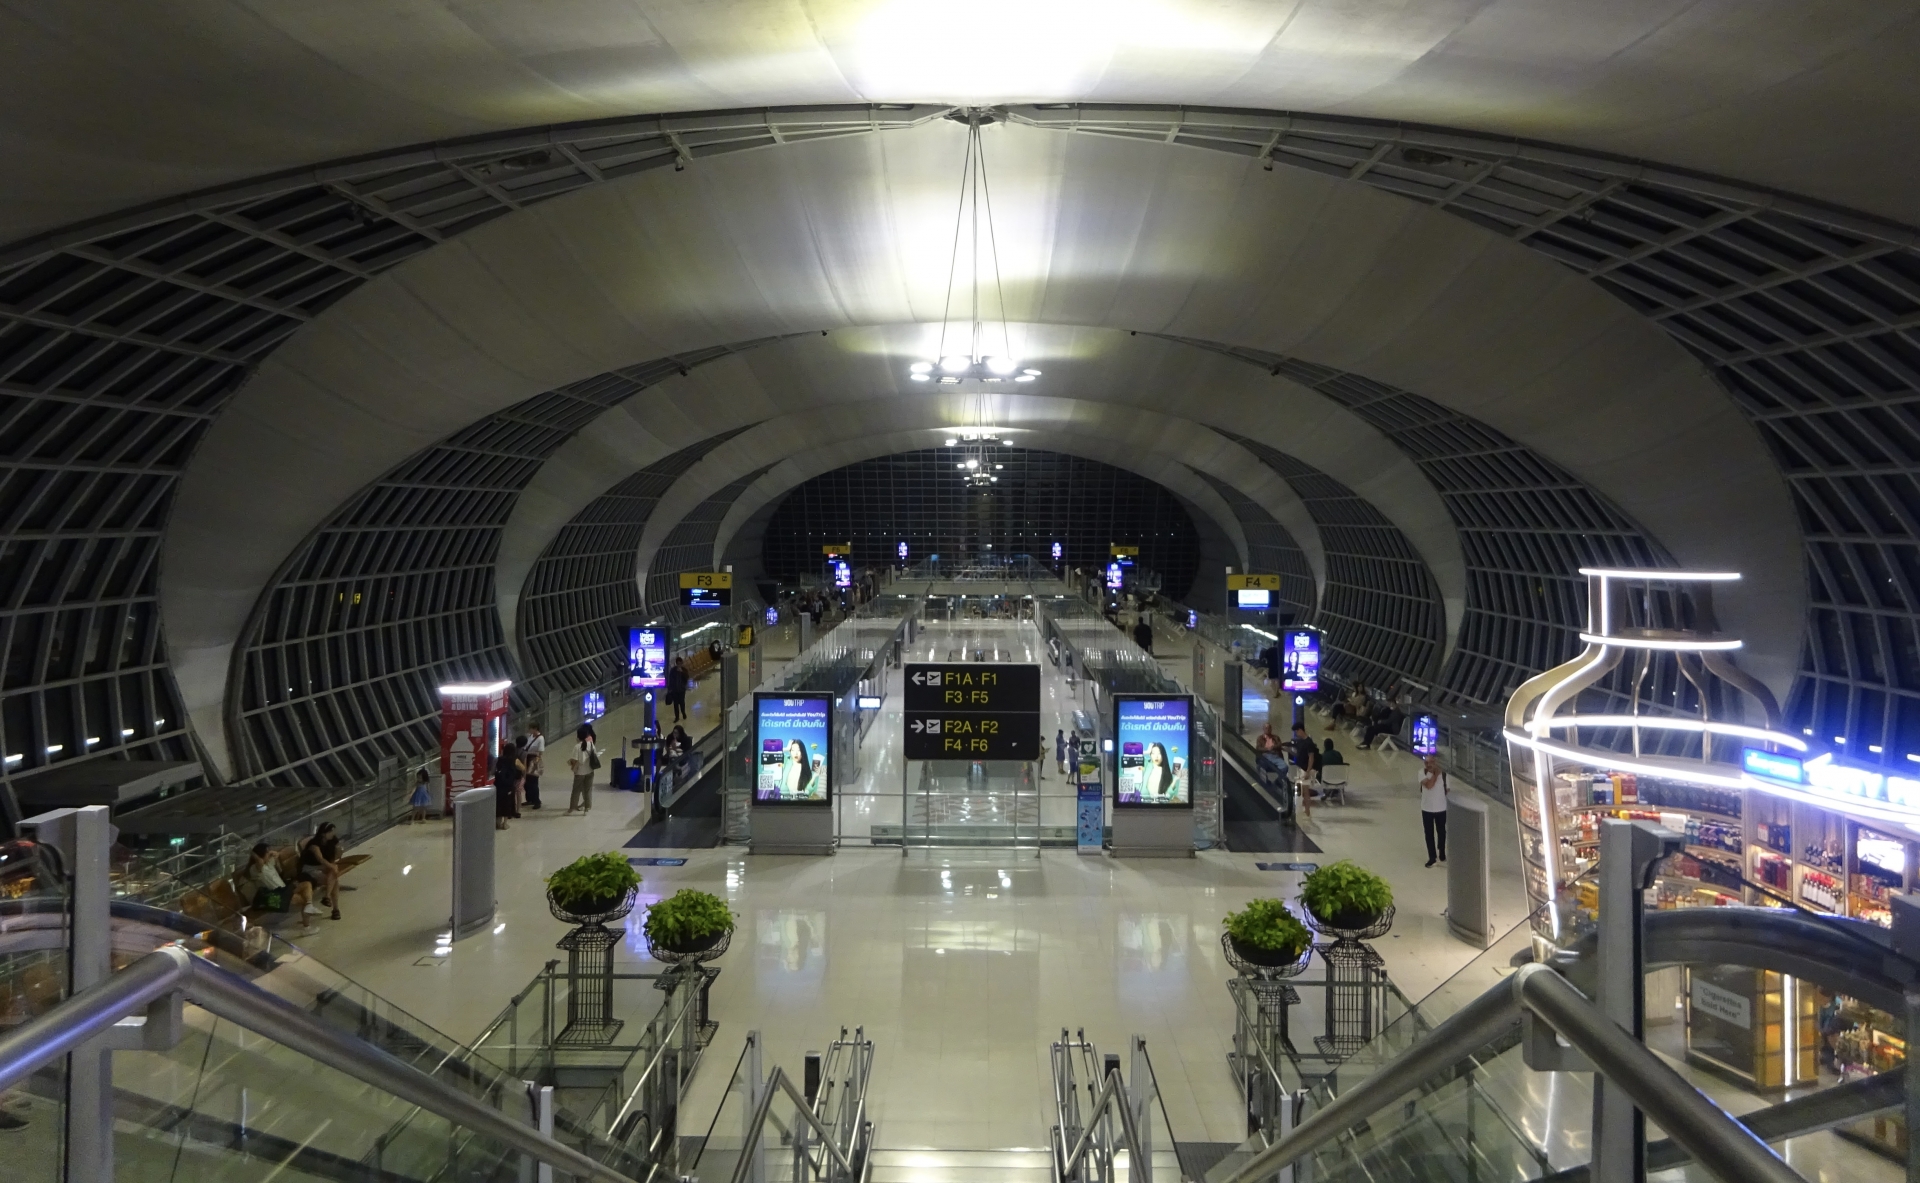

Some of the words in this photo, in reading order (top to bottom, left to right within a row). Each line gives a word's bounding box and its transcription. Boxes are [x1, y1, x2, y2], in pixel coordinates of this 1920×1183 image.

[697, 576, 712, 586] F3
[1246, 577, 1261, 587] F4
[945, 672, 972, 685] F1A
[981, 672, 997, 685] F1
[945, 691, 962, 703] F3
[971, 691, 988, 703] F5
[944, 720, 972, 733] F2A
[981, 721, 998, 733] F2
[944, 739, 962, 751] F4
[971, 739, 988, 751] F6
